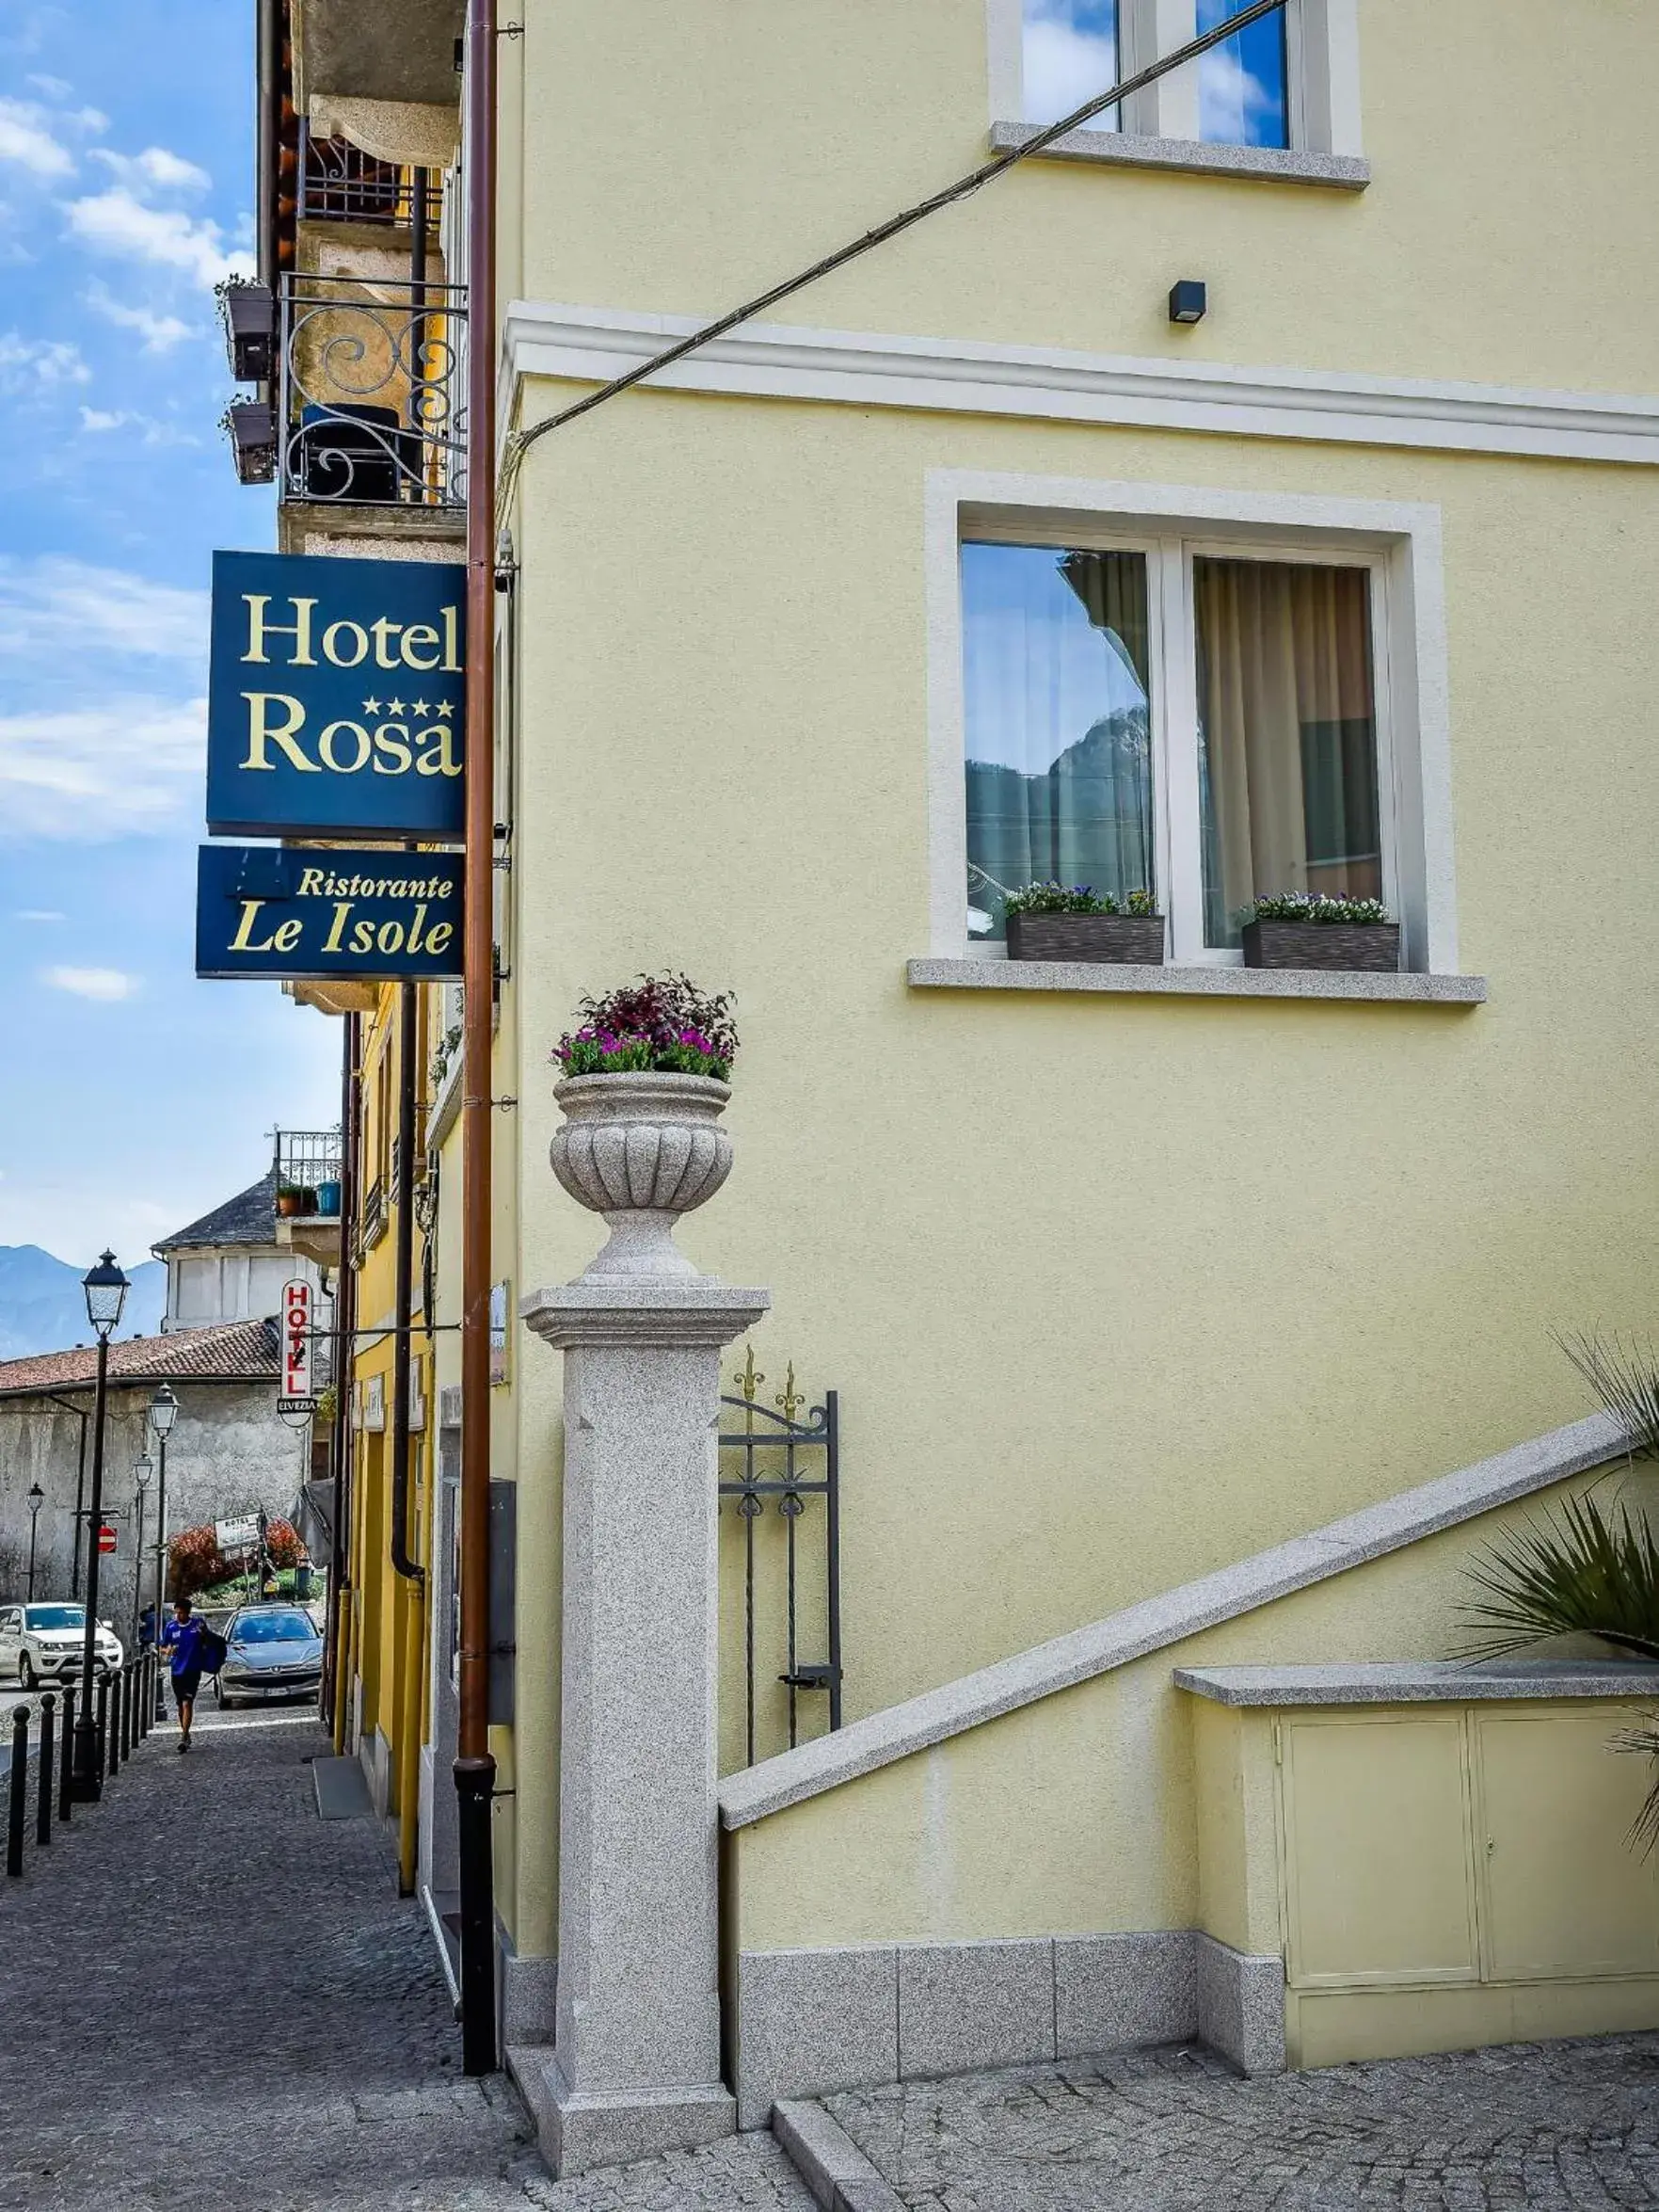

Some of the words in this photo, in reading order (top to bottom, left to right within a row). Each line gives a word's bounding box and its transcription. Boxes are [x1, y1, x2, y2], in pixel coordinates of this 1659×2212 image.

[240, 594, 463, 672] Hotel
[238, 692, 463, 777] Rosa
[296, 868, 454, 899] Ristorante
[227, 900, 304, 953] Le
[321, 902, 454, 954] Isole
[287, 1287, 308, 1394] HOTEL
